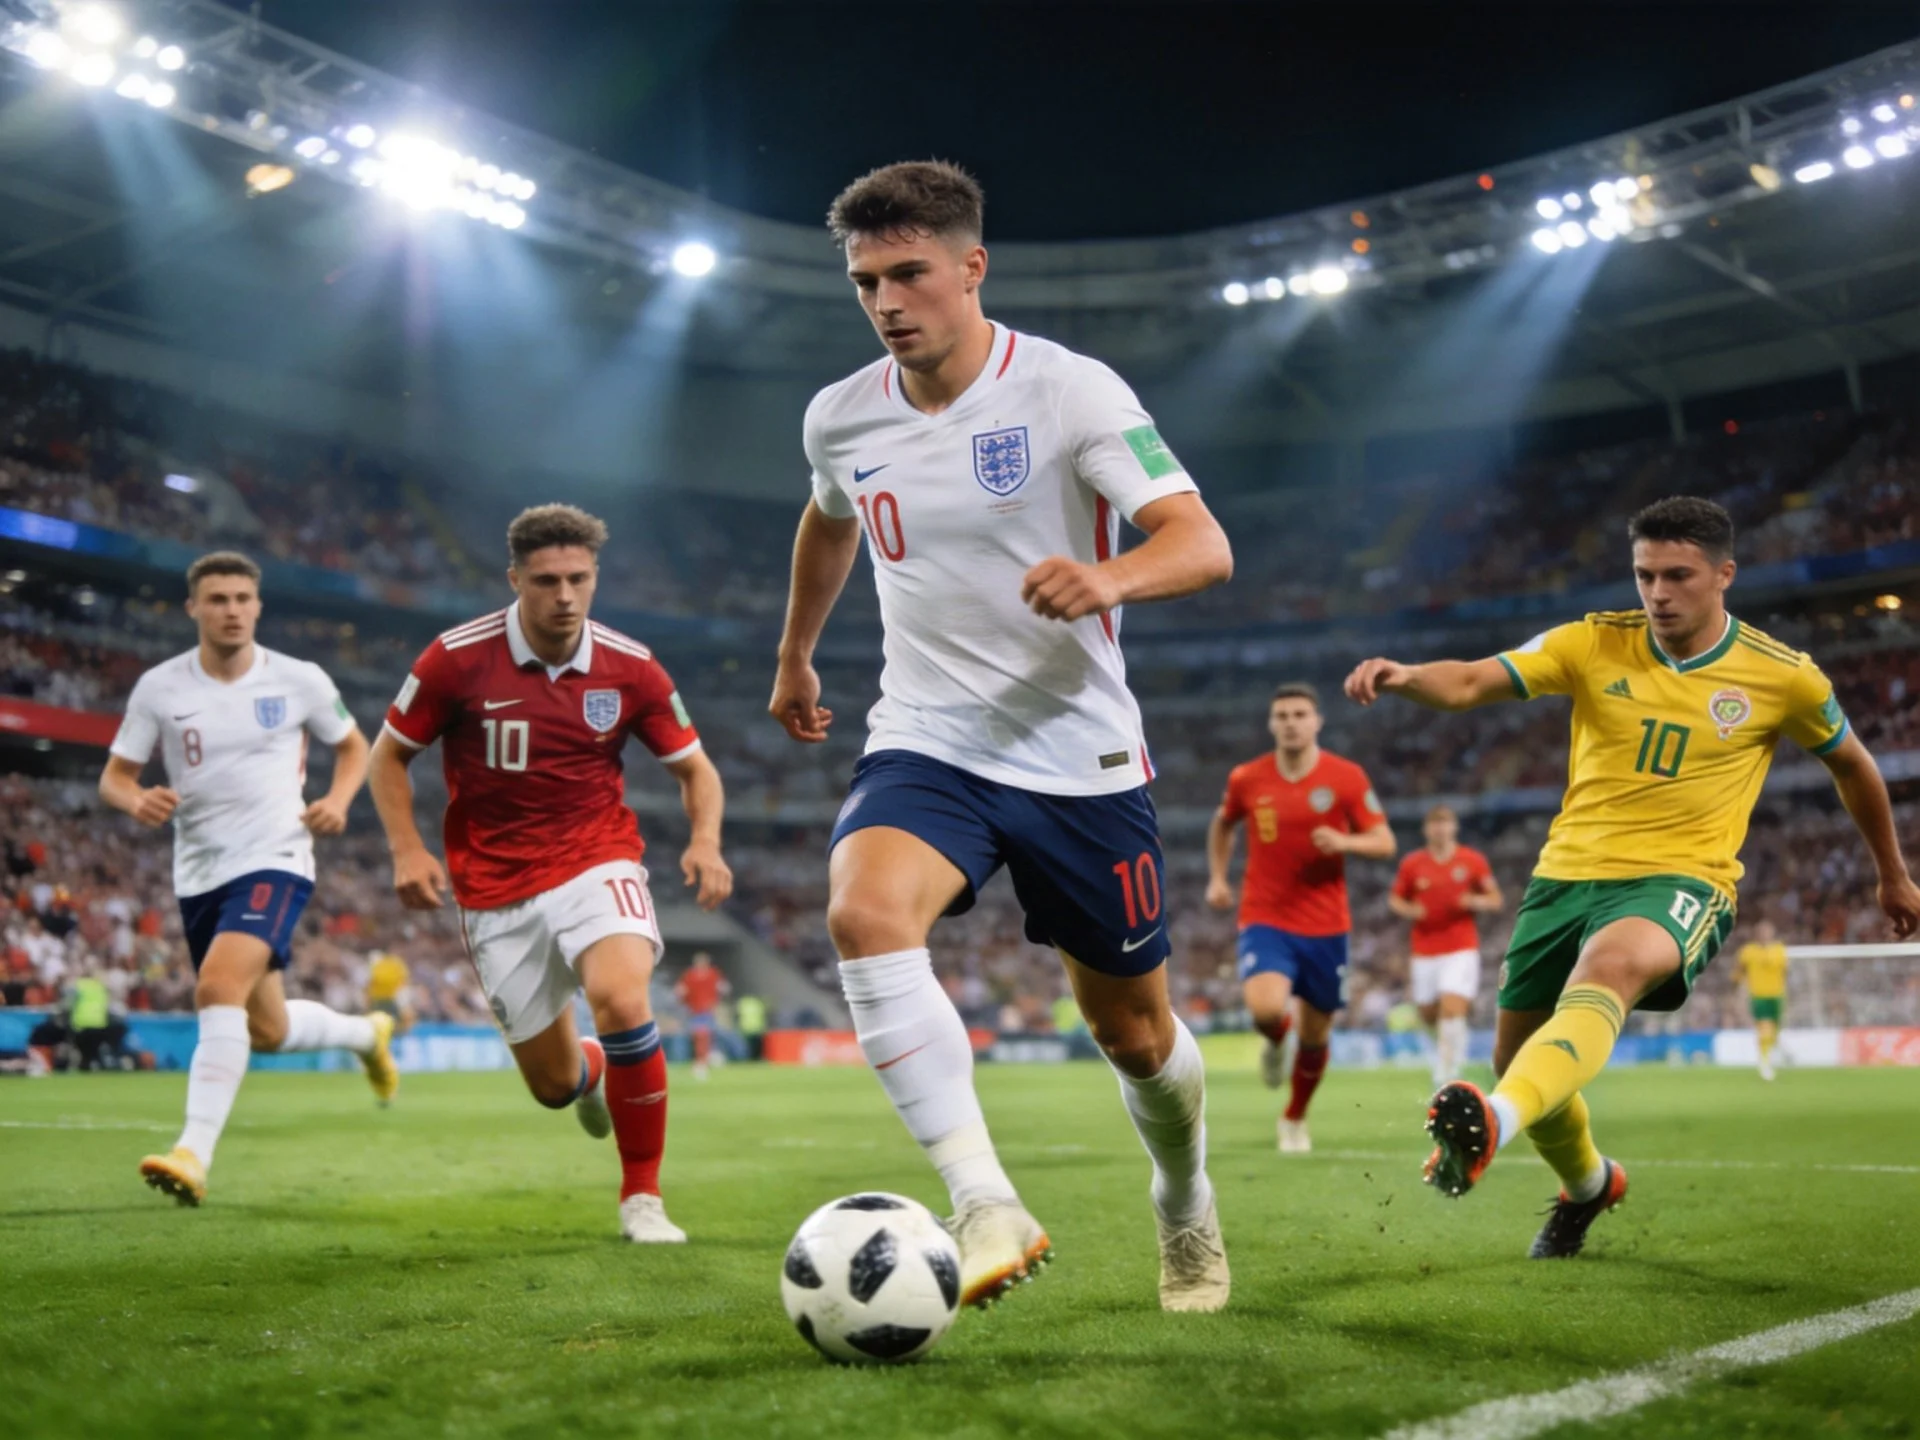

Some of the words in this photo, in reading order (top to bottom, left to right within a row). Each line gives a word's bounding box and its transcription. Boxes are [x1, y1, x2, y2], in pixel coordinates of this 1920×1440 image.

[857, 491, 905, 562] 10
[183, 728, 203, 767] 8
[482, 719, 529, 771] 10
[1634, 718, 1690, 778] 10
[603, 877, 647, 920] 10
[1113, 851, 1160, 928] 10
